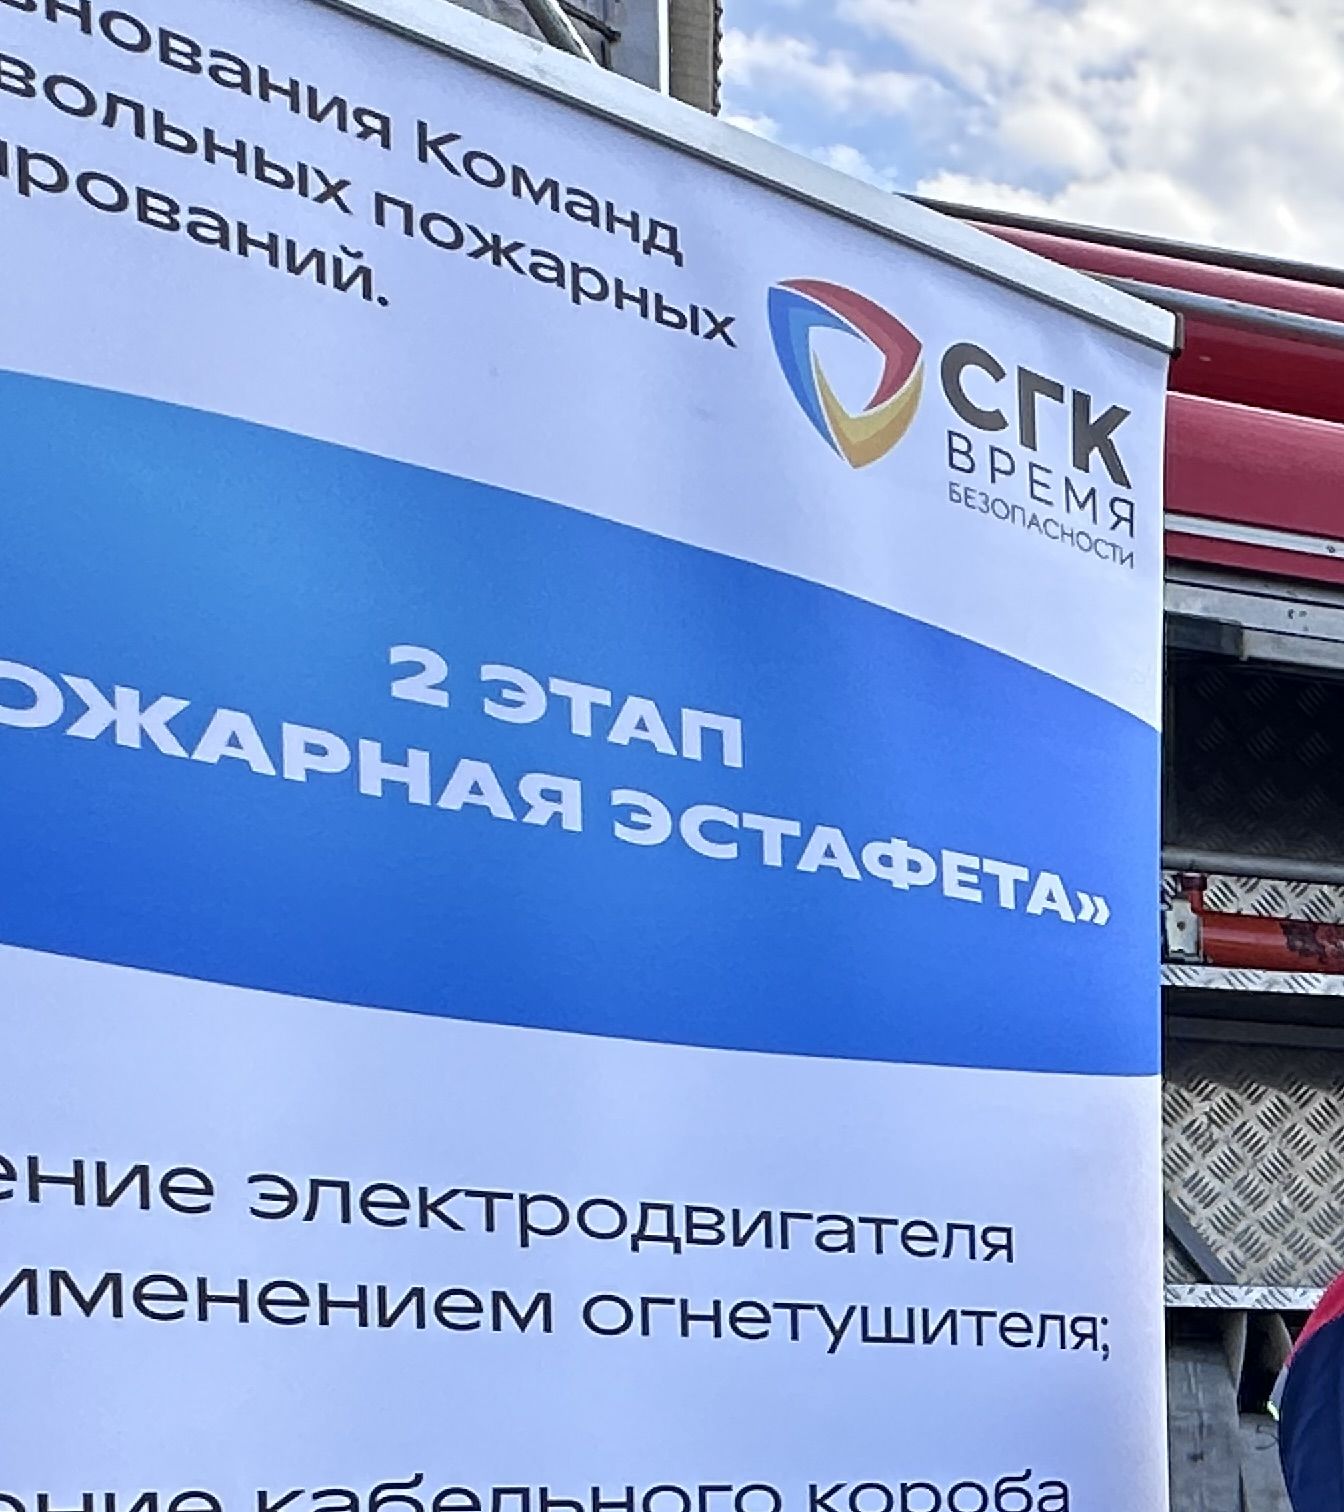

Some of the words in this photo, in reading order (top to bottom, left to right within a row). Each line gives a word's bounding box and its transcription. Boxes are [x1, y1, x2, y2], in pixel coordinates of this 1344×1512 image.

[0, 0, 392, 151] нования
[416, 119, 685, 268] Команд
[0, 53, 354, 216] вольных
[374, 191, 737, 348] пожарных
[0, 139, 390, 308] рований.
[941, 342, 1132, 490] СГК
[947, 430, 1135, 539] ВРЕМЯ
[948, 481, 1134, 569] БЕЗОПАСНОСТИ
[390, 644, 450, 708] 2
[480, 664, 743, 768] ЭТАП
[0, 659, 583, 832] ОЖАРНАЯ
[611, 788, 1111, 926] ЭСТАФЕТА»
[247, 1173, 1015, 1264] электродвигателя
[0, 1268, 553, 1334] именением
[582, 1294, 1110, 1362] огнетушителя;
